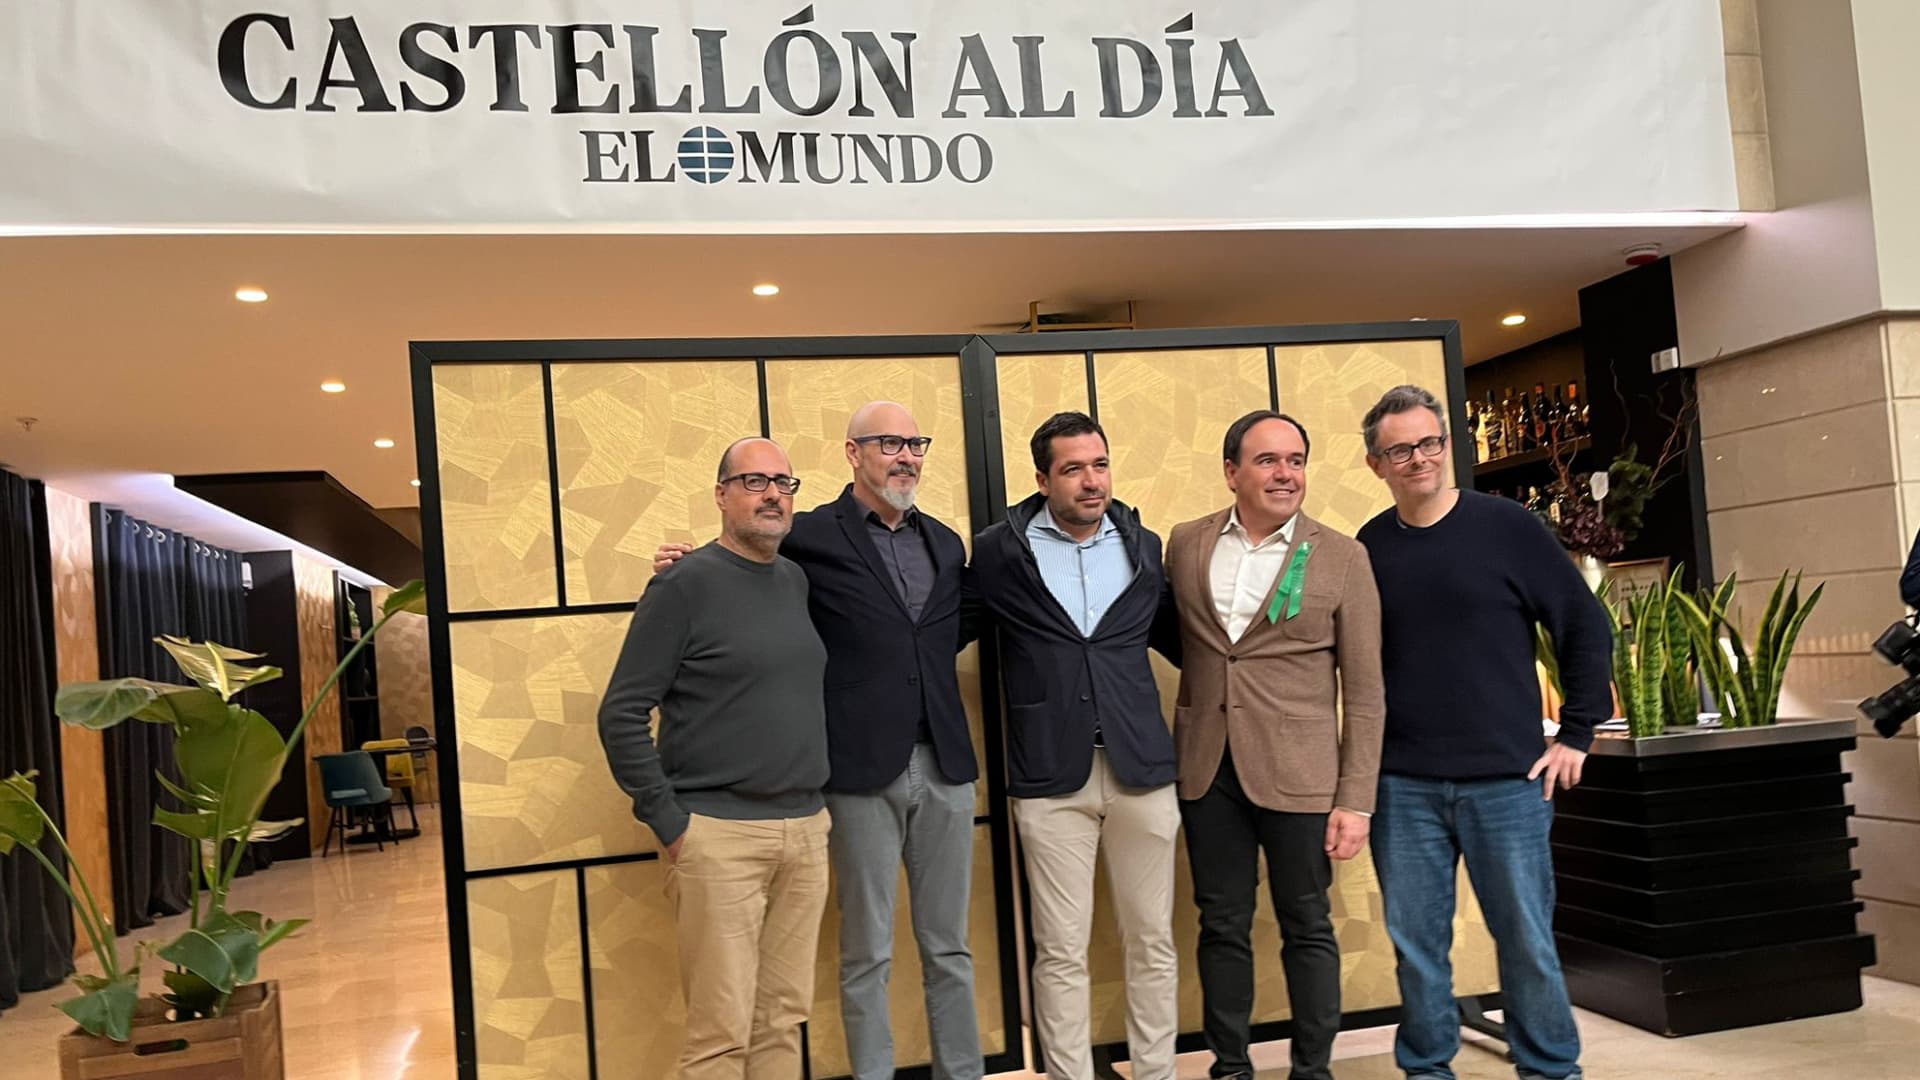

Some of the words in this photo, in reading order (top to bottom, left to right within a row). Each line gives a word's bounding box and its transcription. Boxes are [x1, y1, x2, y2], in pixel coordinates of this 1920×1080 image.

[217, 5, 917, 117] CASTELLÓN
[942, 33, 1075, 118] AL
[1092, 12, 1275, 118] DÍA
[580, 130, 676, 183] EL
[737, 130, 993, 184] MUNDO
